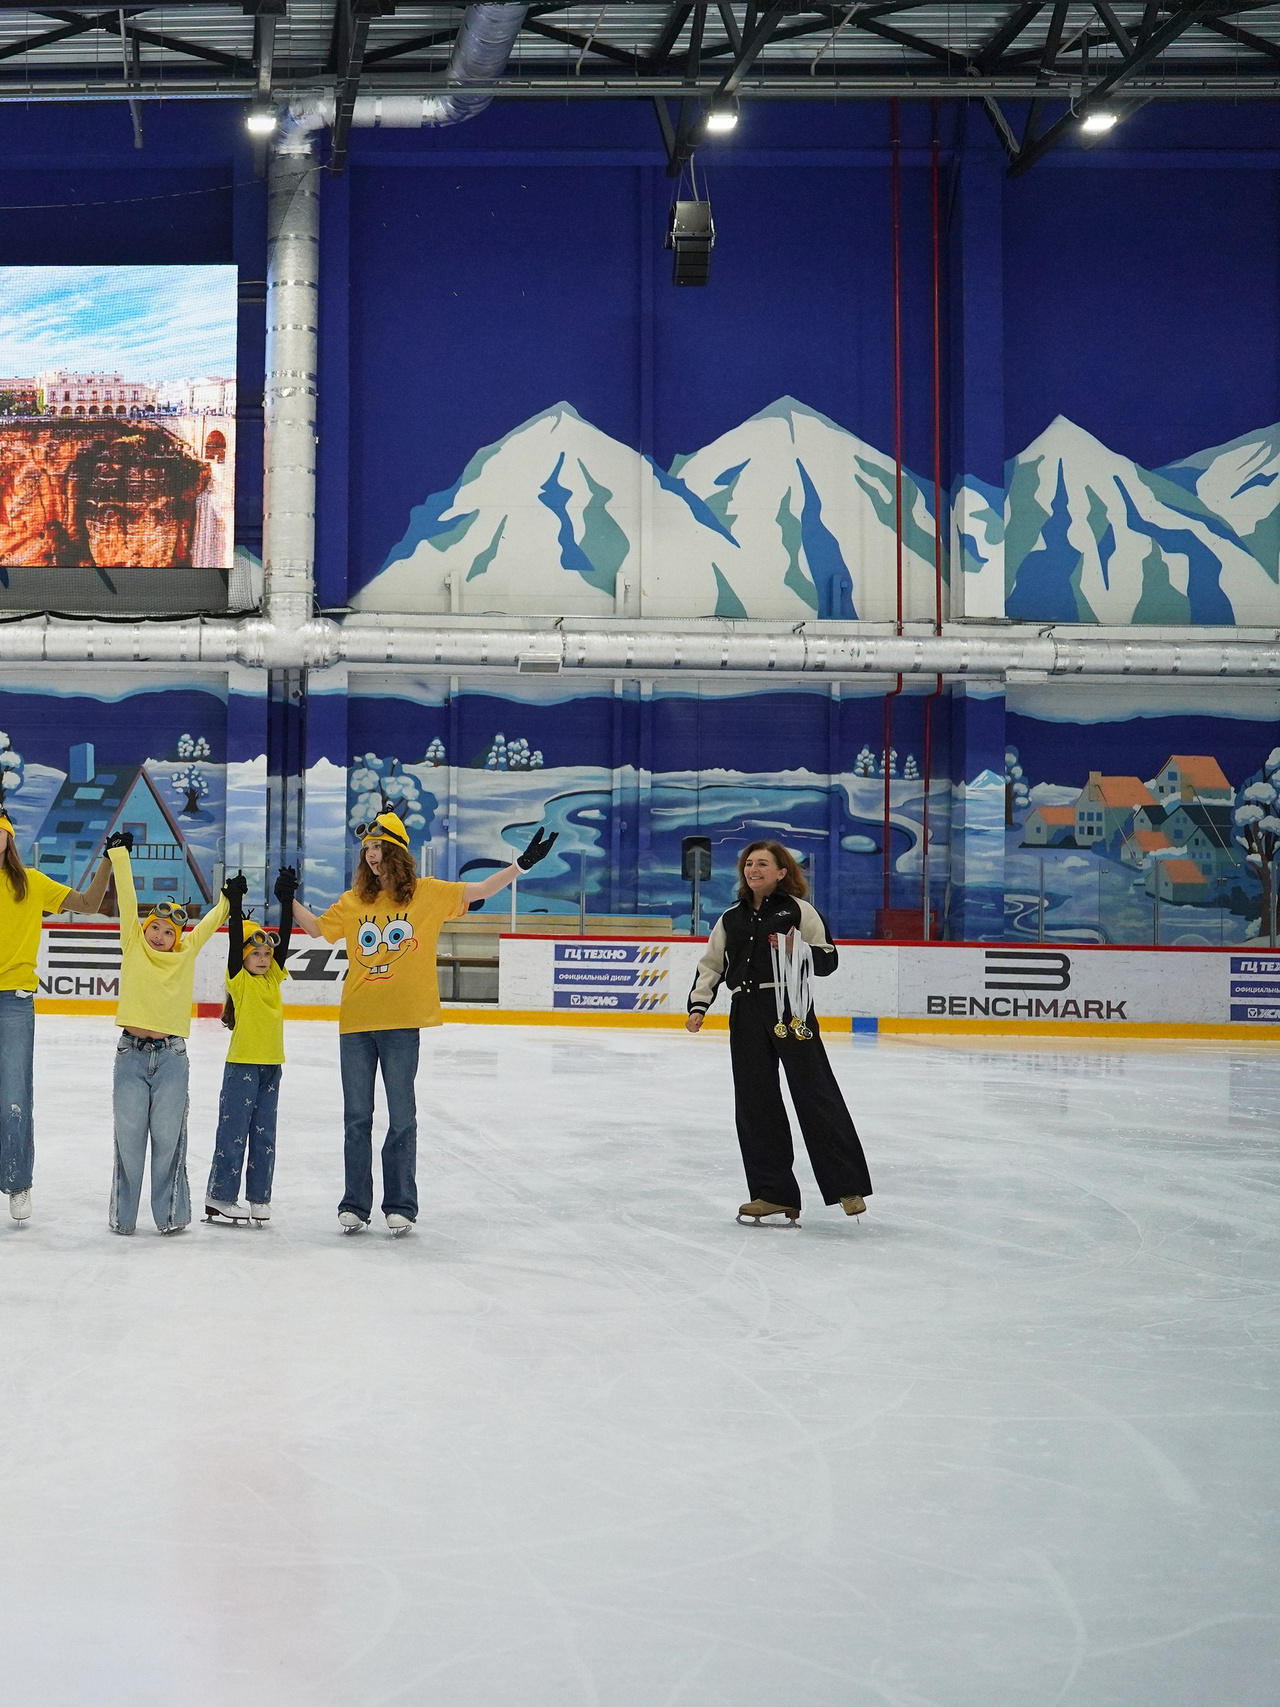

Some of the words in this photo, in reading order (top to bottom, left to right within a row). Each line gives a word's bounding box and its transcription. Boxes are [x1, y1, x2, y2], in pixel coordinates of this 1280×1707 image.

[564, 948, 582, 960] ГЦ
[583, 949, 627, 960] ТЕХНО
[1240, 961, 1258, 973] ГЦ
[558, 973, 610, 982] ОФИЦИАЛЬНЫЙ
[581, 995, 619, 1006] XCMG
[927, 995, 1128, 1020] BENCHMARK
